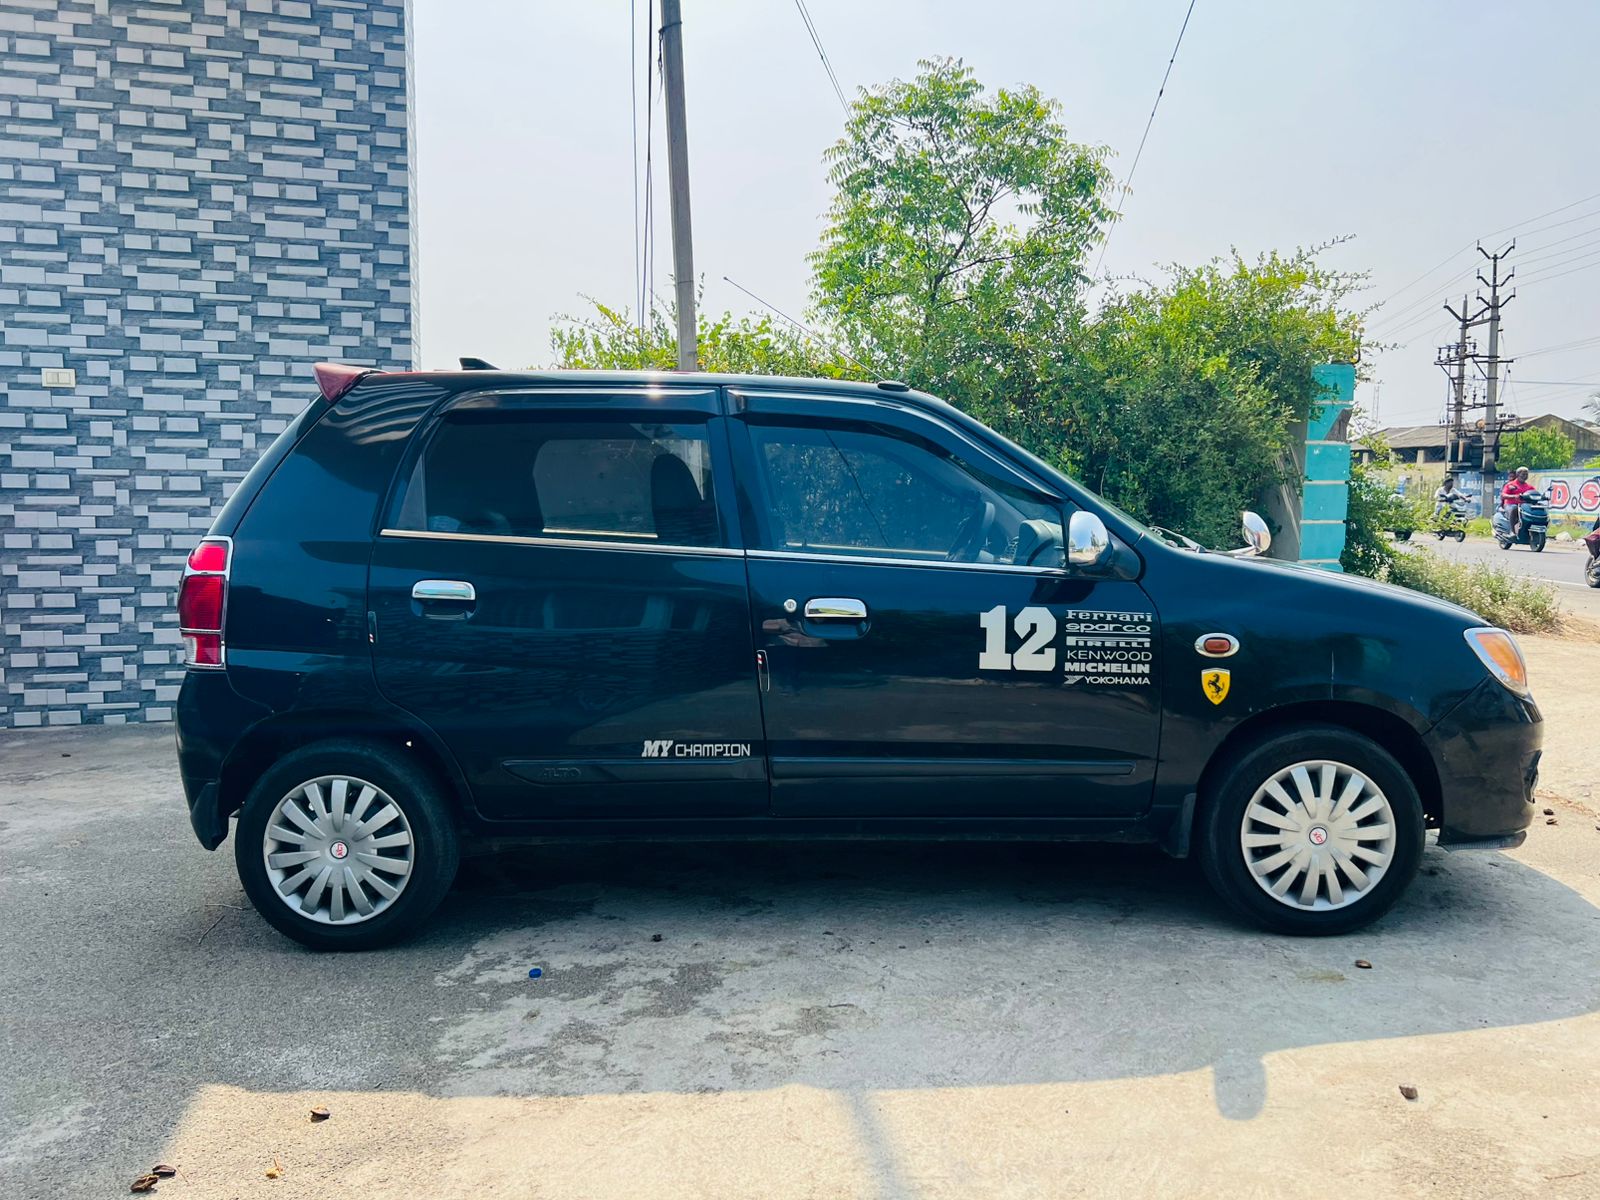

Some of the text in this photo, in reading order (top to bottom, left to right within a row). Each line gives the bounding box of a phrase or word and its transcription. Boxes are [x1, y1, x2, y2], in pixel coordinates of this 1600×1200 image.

[1065, 609, 1152, 622] Ferrari
[1065, 622, 1151, 634] sparco
[979, 605, 1057, 671] 12
[1066, 636, 1151, 648] PIRELLI
[1067, 649, 1152, 662] KENWOOD
[1064, 661, 1150, 674] MICHELIN
[1084, 675, 1151, 685] YOKOHAMA
[641, 740, 750, 757] MY CHAMPION
